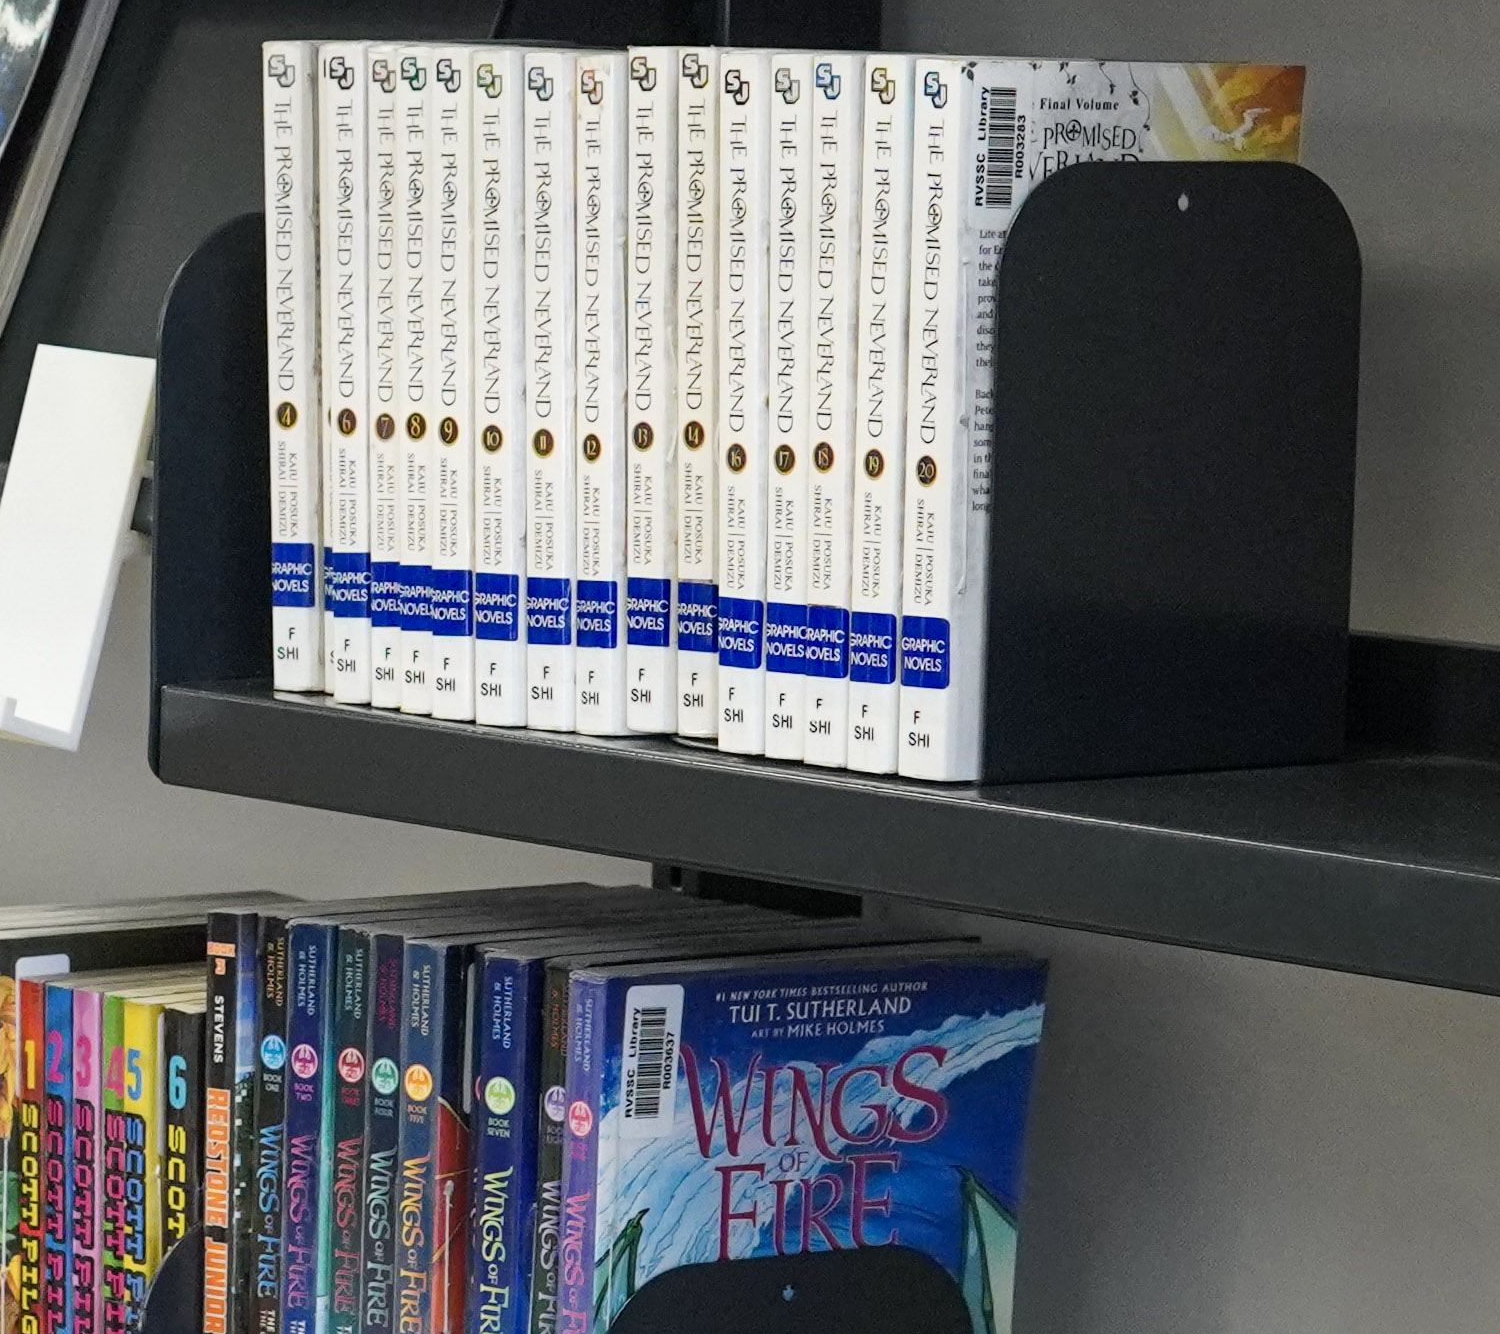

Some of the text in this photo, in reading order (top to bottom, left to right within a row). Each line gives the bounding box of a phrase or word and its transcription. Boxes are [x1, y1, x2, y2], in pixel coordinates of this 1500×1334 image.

[1040, 98, 1119, 110] Final Volume
[1015, 115, 1027, 178] R003283
[273, 98, 295, 392] THE PROMISED NEVERLAND
[918, 462, 934, 480] 20
[902, 636, 945, 653] GRAPHIC
[904, 657, 942, 672] NOVELS
[212, 995, 225, 1063] STEVENS
[729, 996, 912, 1023] TUI T. SUTHERLAND
[788, 1019, 885, 1037] MIKE HOLMES
[25, 1040, 36, 1090] 1
[169, 1055, 187, 1110] 6
[680, 1044, 949, 1162] WINGS
[21, 1099, 40, 1232] SCOTT
[205, 1087, 231, 1230] REDSTONE
[778, 1151, 809, 1172] OF
[479, 1165, 514, 1263] WINGS
[715, 1152, 900, 1261] FIRE
[487, 1265, 500, 1287] OF
